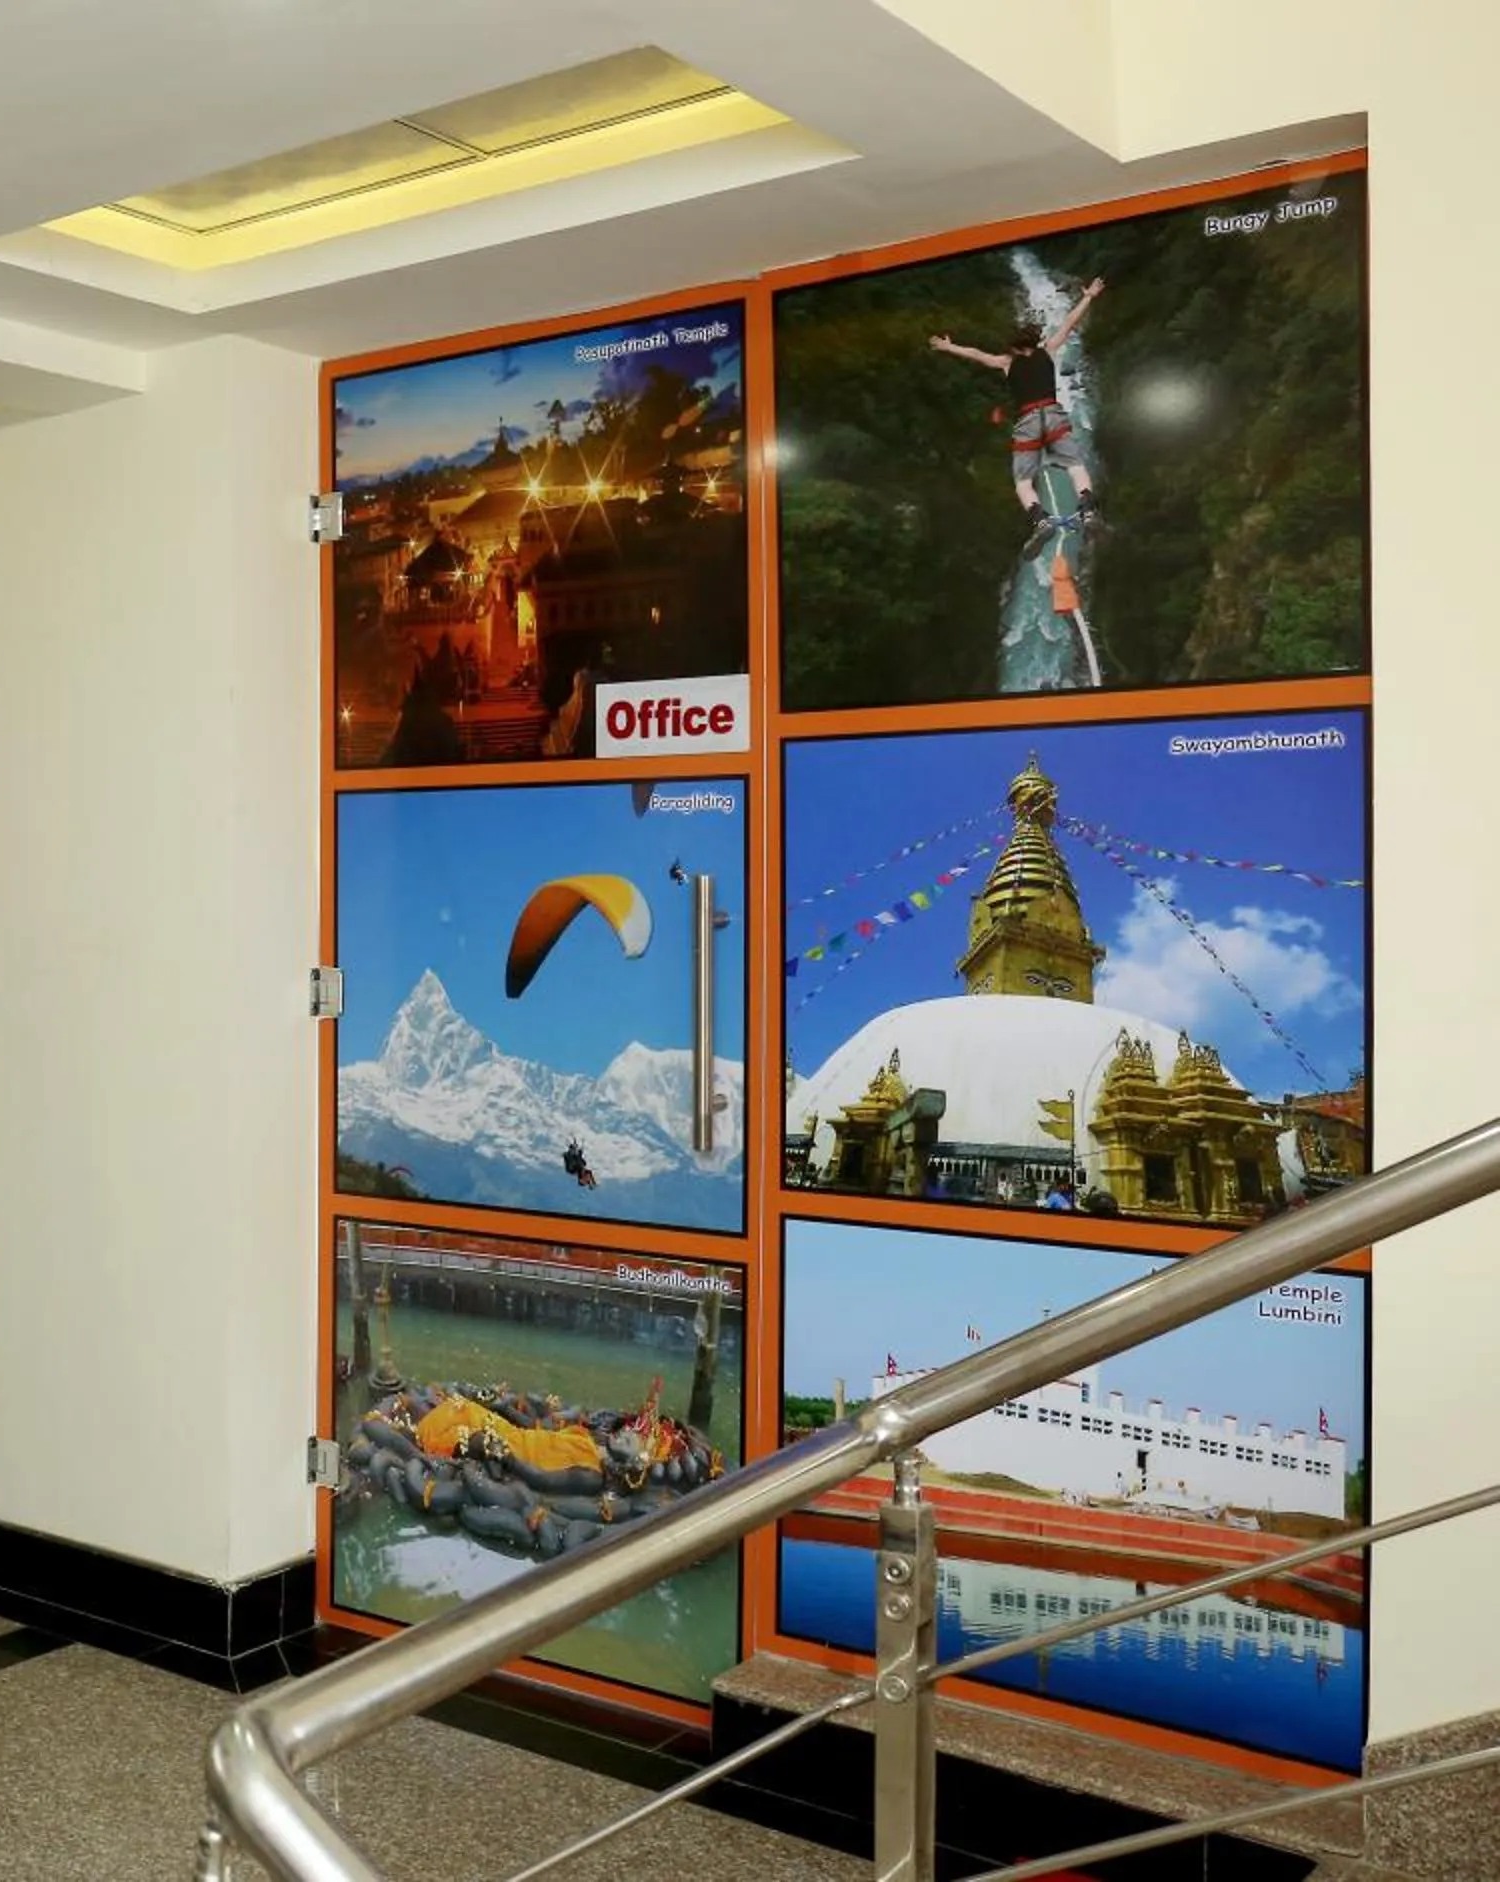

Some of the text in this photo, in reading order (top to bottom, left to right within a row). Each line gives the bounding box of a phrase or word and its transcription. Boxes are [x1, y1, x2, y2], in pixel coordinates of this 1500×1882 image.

[1205, 197, 1338, 236] Bungy Jump
[672, 321, 729, 344] Temple
[606, 698, 735, 740] Office
[1170, 727, 1345, 757] Swayambhunath
[650, 792, 735, 814] Paragliding
[1259, 1300, 1342, 1326] Lumbini
